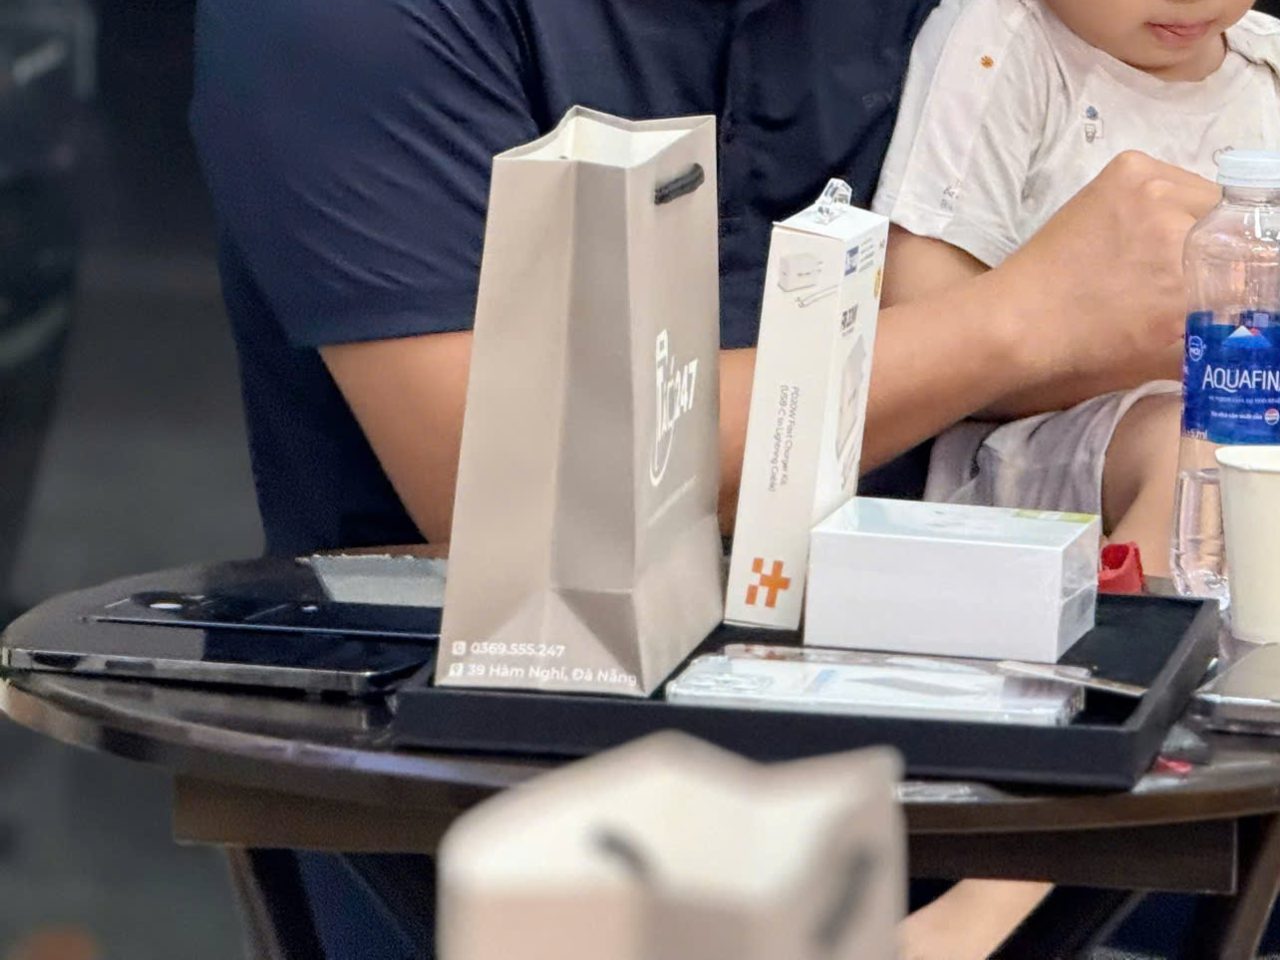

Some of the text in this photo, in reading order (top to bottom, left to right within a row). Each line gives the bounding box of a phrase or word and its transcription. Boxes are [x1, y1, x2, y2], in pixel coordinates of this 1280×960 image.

[470, 642, 566, 658] 0369.555.247
[467, 664, 486, 676] 39
[488, 663, 524, 678] Hàm
[572, 666, 593, 682] Đà
